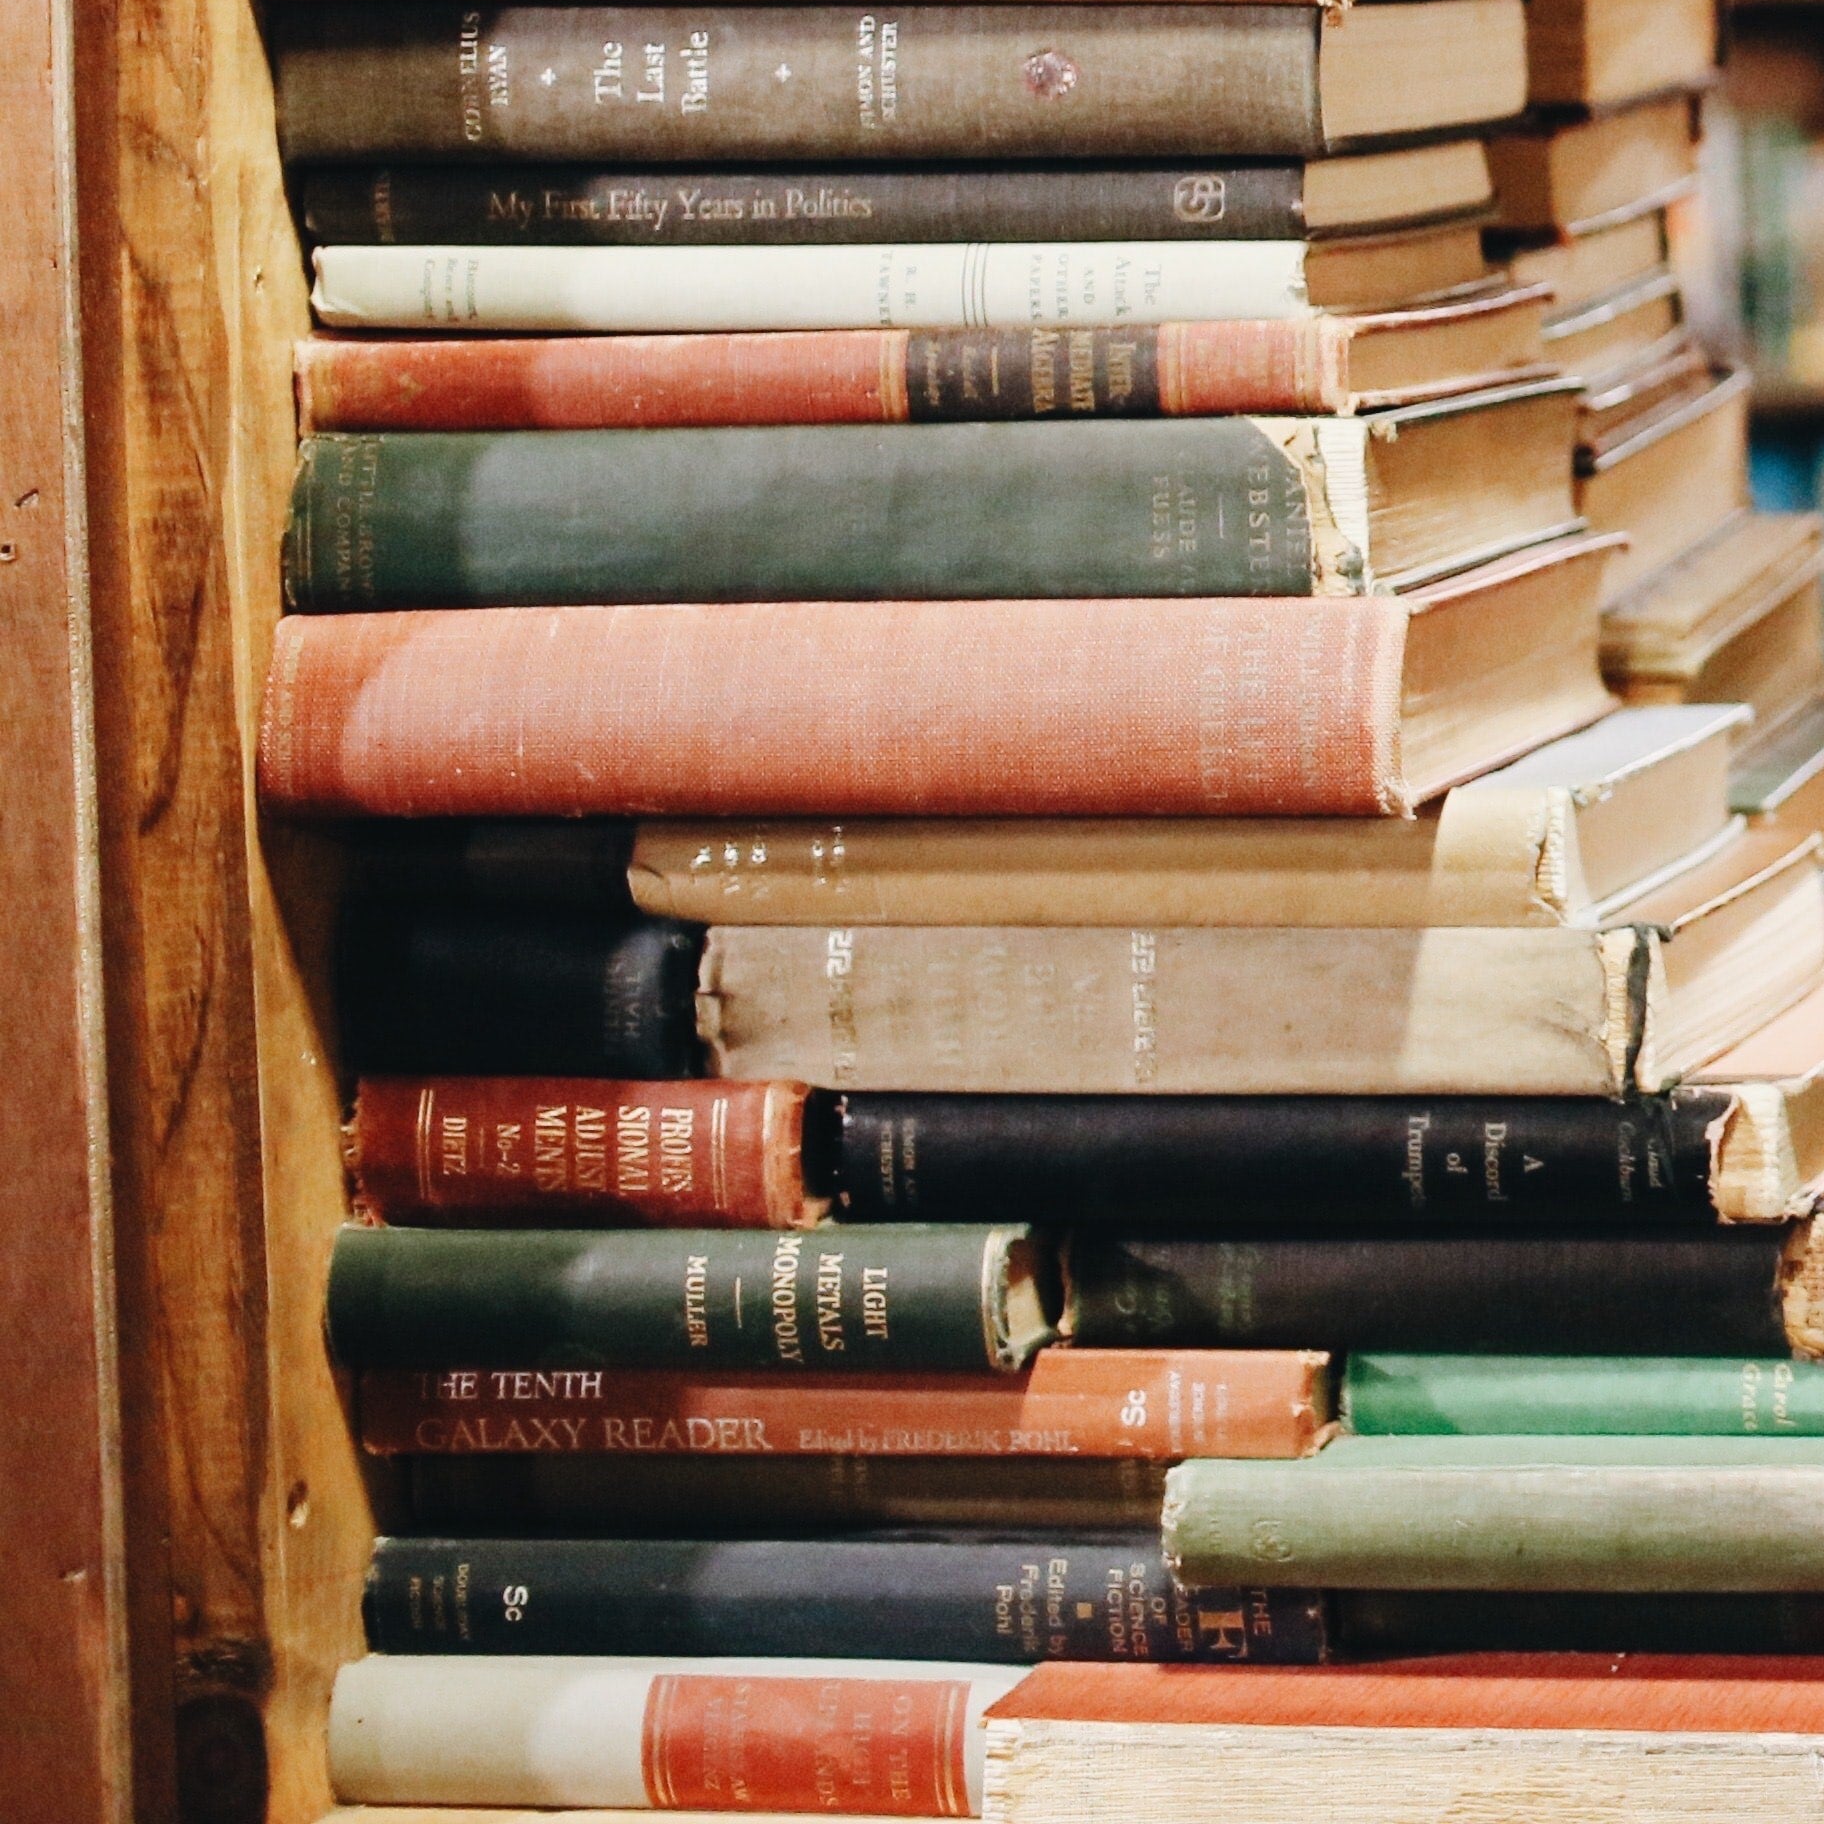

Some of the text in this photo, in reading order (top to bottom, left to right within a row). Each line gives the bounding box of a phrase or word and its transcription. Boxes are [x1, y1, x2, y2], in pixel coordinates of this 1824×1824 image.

[595, 42, 622, 103] The
[638, 42, 664, 105] Last
[682, 30, 709, 113] Battle
[489, 189, 872, 228] My First Fifty Years in Politics
[686, 1254, 707, 1347] MULLER
[774, 1235, 800, 1362] MONOPOLY
[818, 1253, 844, 1350] METALS
[865, 1267, 887, 1340] LIGHT
[492, 1371, 602, 1399] TENTH
[1122, 1388, 1146, 1424] Sc
[415, 1417, 772, 1450] GALAXY READER
[502, 1583, 527, 1622] Sc
